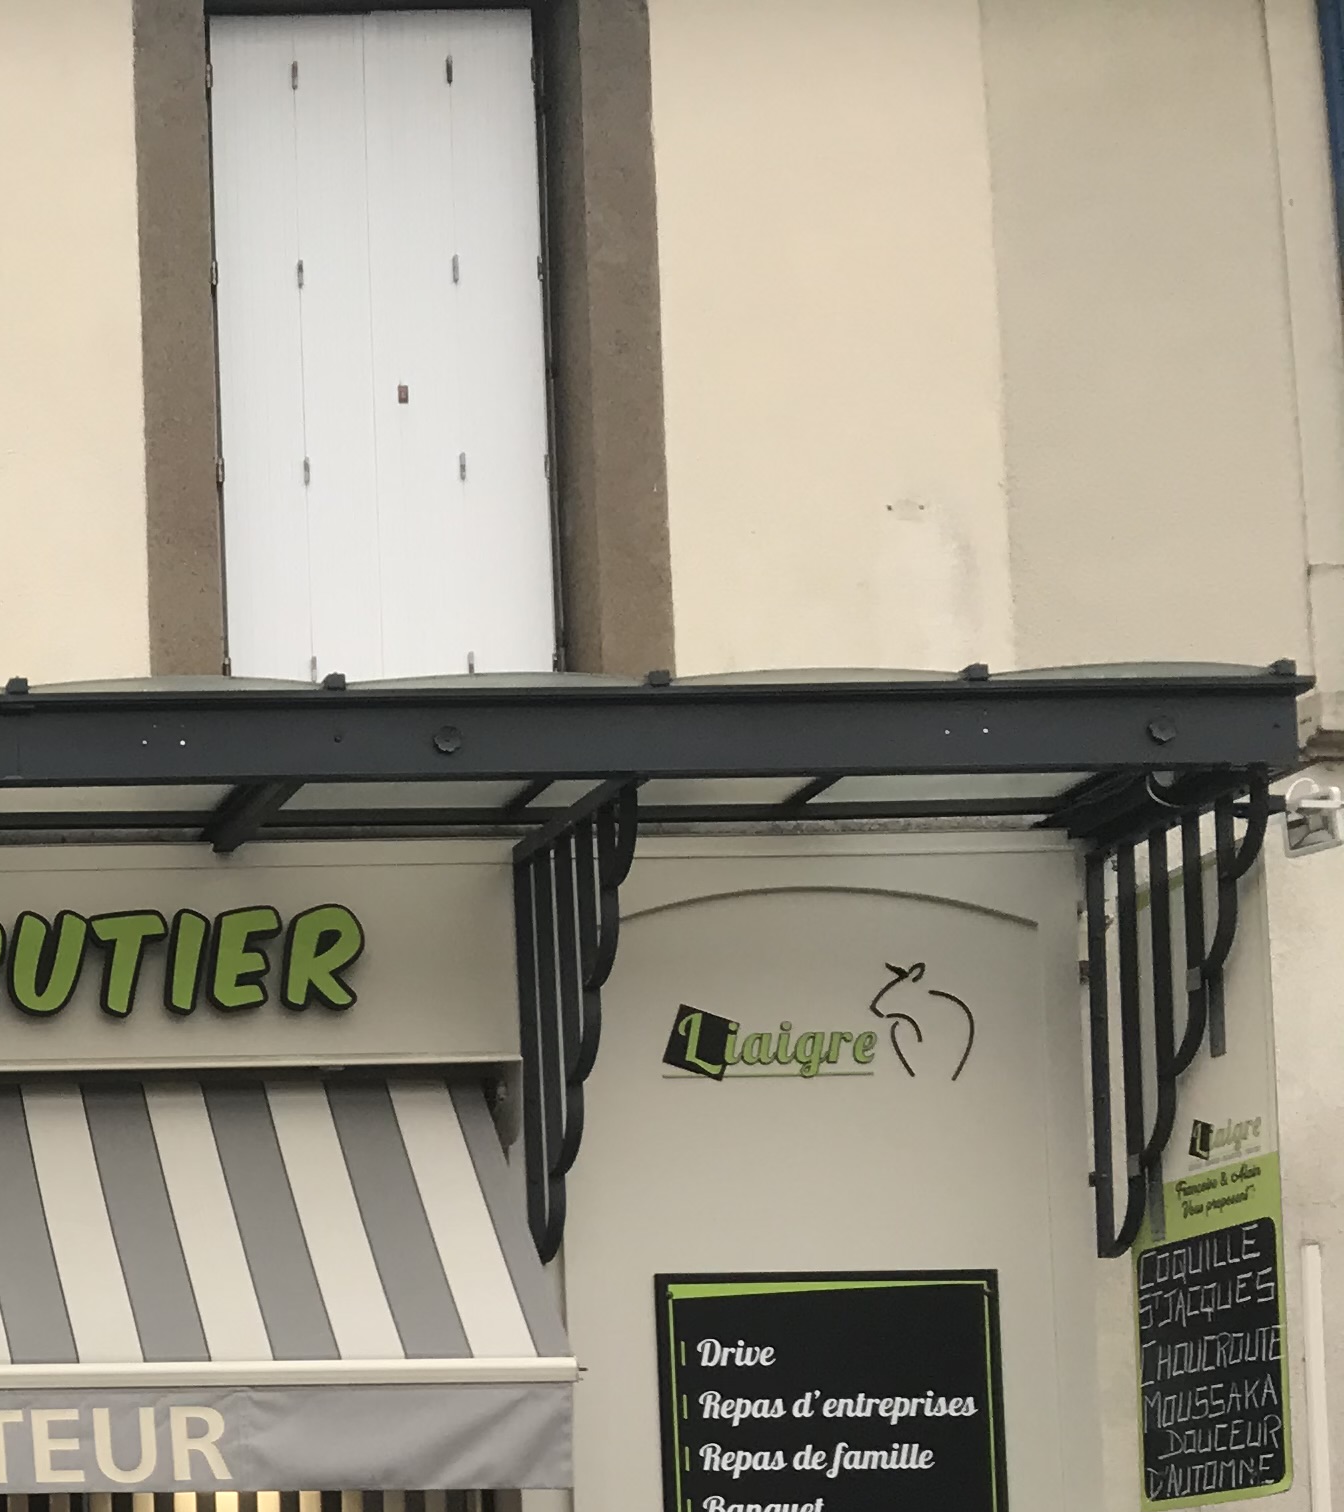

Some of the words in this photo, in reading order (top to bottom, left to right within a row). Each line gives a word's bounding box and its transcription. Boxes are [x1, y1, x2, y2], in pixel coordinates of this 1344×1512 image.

[676, 1011, 878, 1079] Liaigre
[1139, 1223, 1261, 1290] COQUILLE
[696, 1338, 776, 1367] Drive
[1140, 1324, 1285, 1388] CHOUCROUTE
[699, 1390, 787, 1426] Repas
[1143, 1373, 1278, 1434] MOUSSAKA
[699, 1442, 787, 1479] Repas
[792, 1444, 828, 1470] de
[825, 1442, 935, 1479] famille
[1157, 1414, 1282, 1460] DOUCEUR
[1146, 1453, 1275, 1500] D'AUTOMNE
